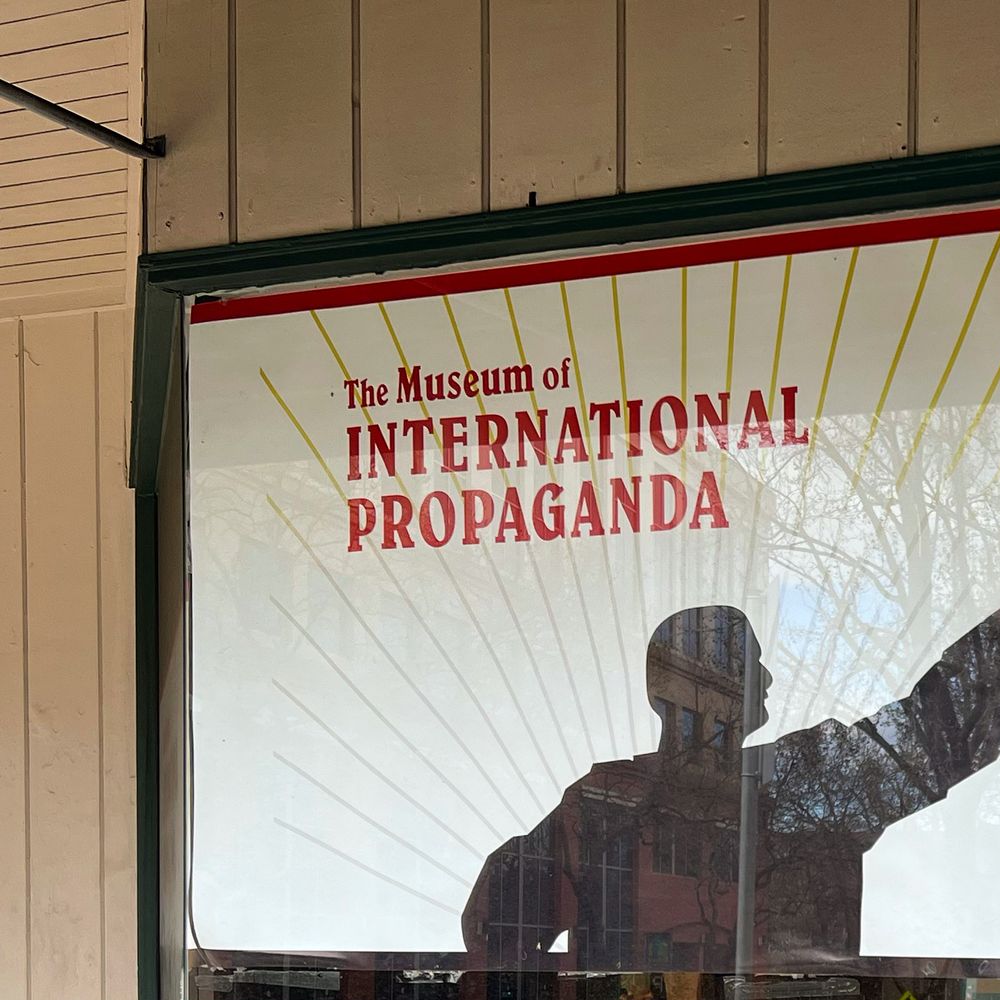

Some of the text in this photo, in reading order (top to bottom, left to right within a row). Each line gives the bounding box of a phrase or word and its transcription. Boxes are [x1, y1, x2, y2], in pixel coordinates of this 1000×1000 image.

[344, 357, 571, 409] The Museum of
[346, 385, 809, 481] INTERNATIONAL
[346, 470, 730, 553] PROPAGANDA
